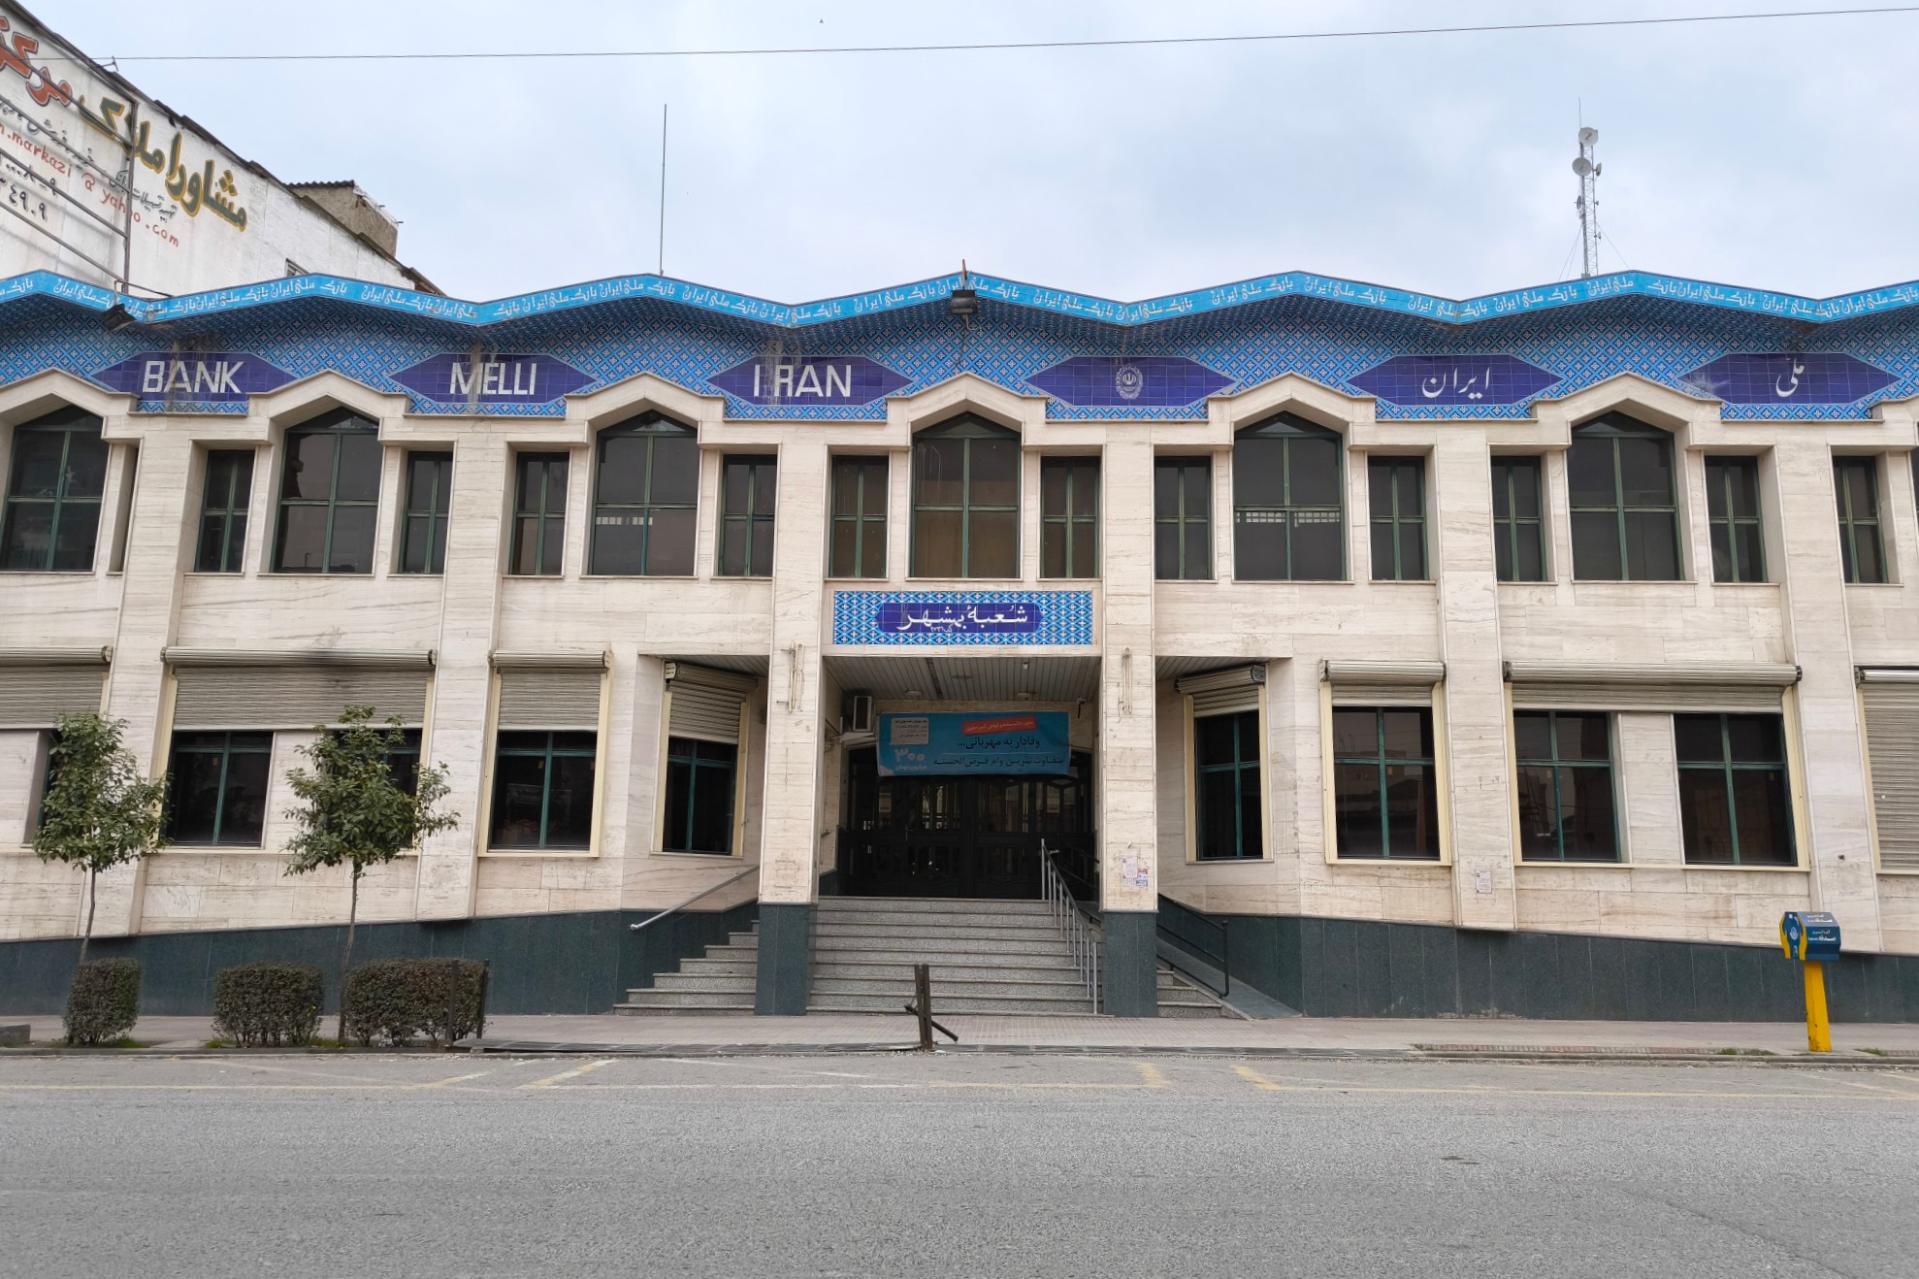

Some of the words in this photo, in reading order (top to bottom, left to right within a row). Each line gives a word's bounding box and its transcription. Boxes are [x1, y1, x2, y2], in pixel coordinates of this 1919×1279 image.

[142, 361, 244, 393] BANK
[450, 362, 537, 395] MELLI
[753, 364, 852, 398] IRAN
[1422, 367, 1490, 399] ایران
[896, 605, 967, 630] بهشهر
